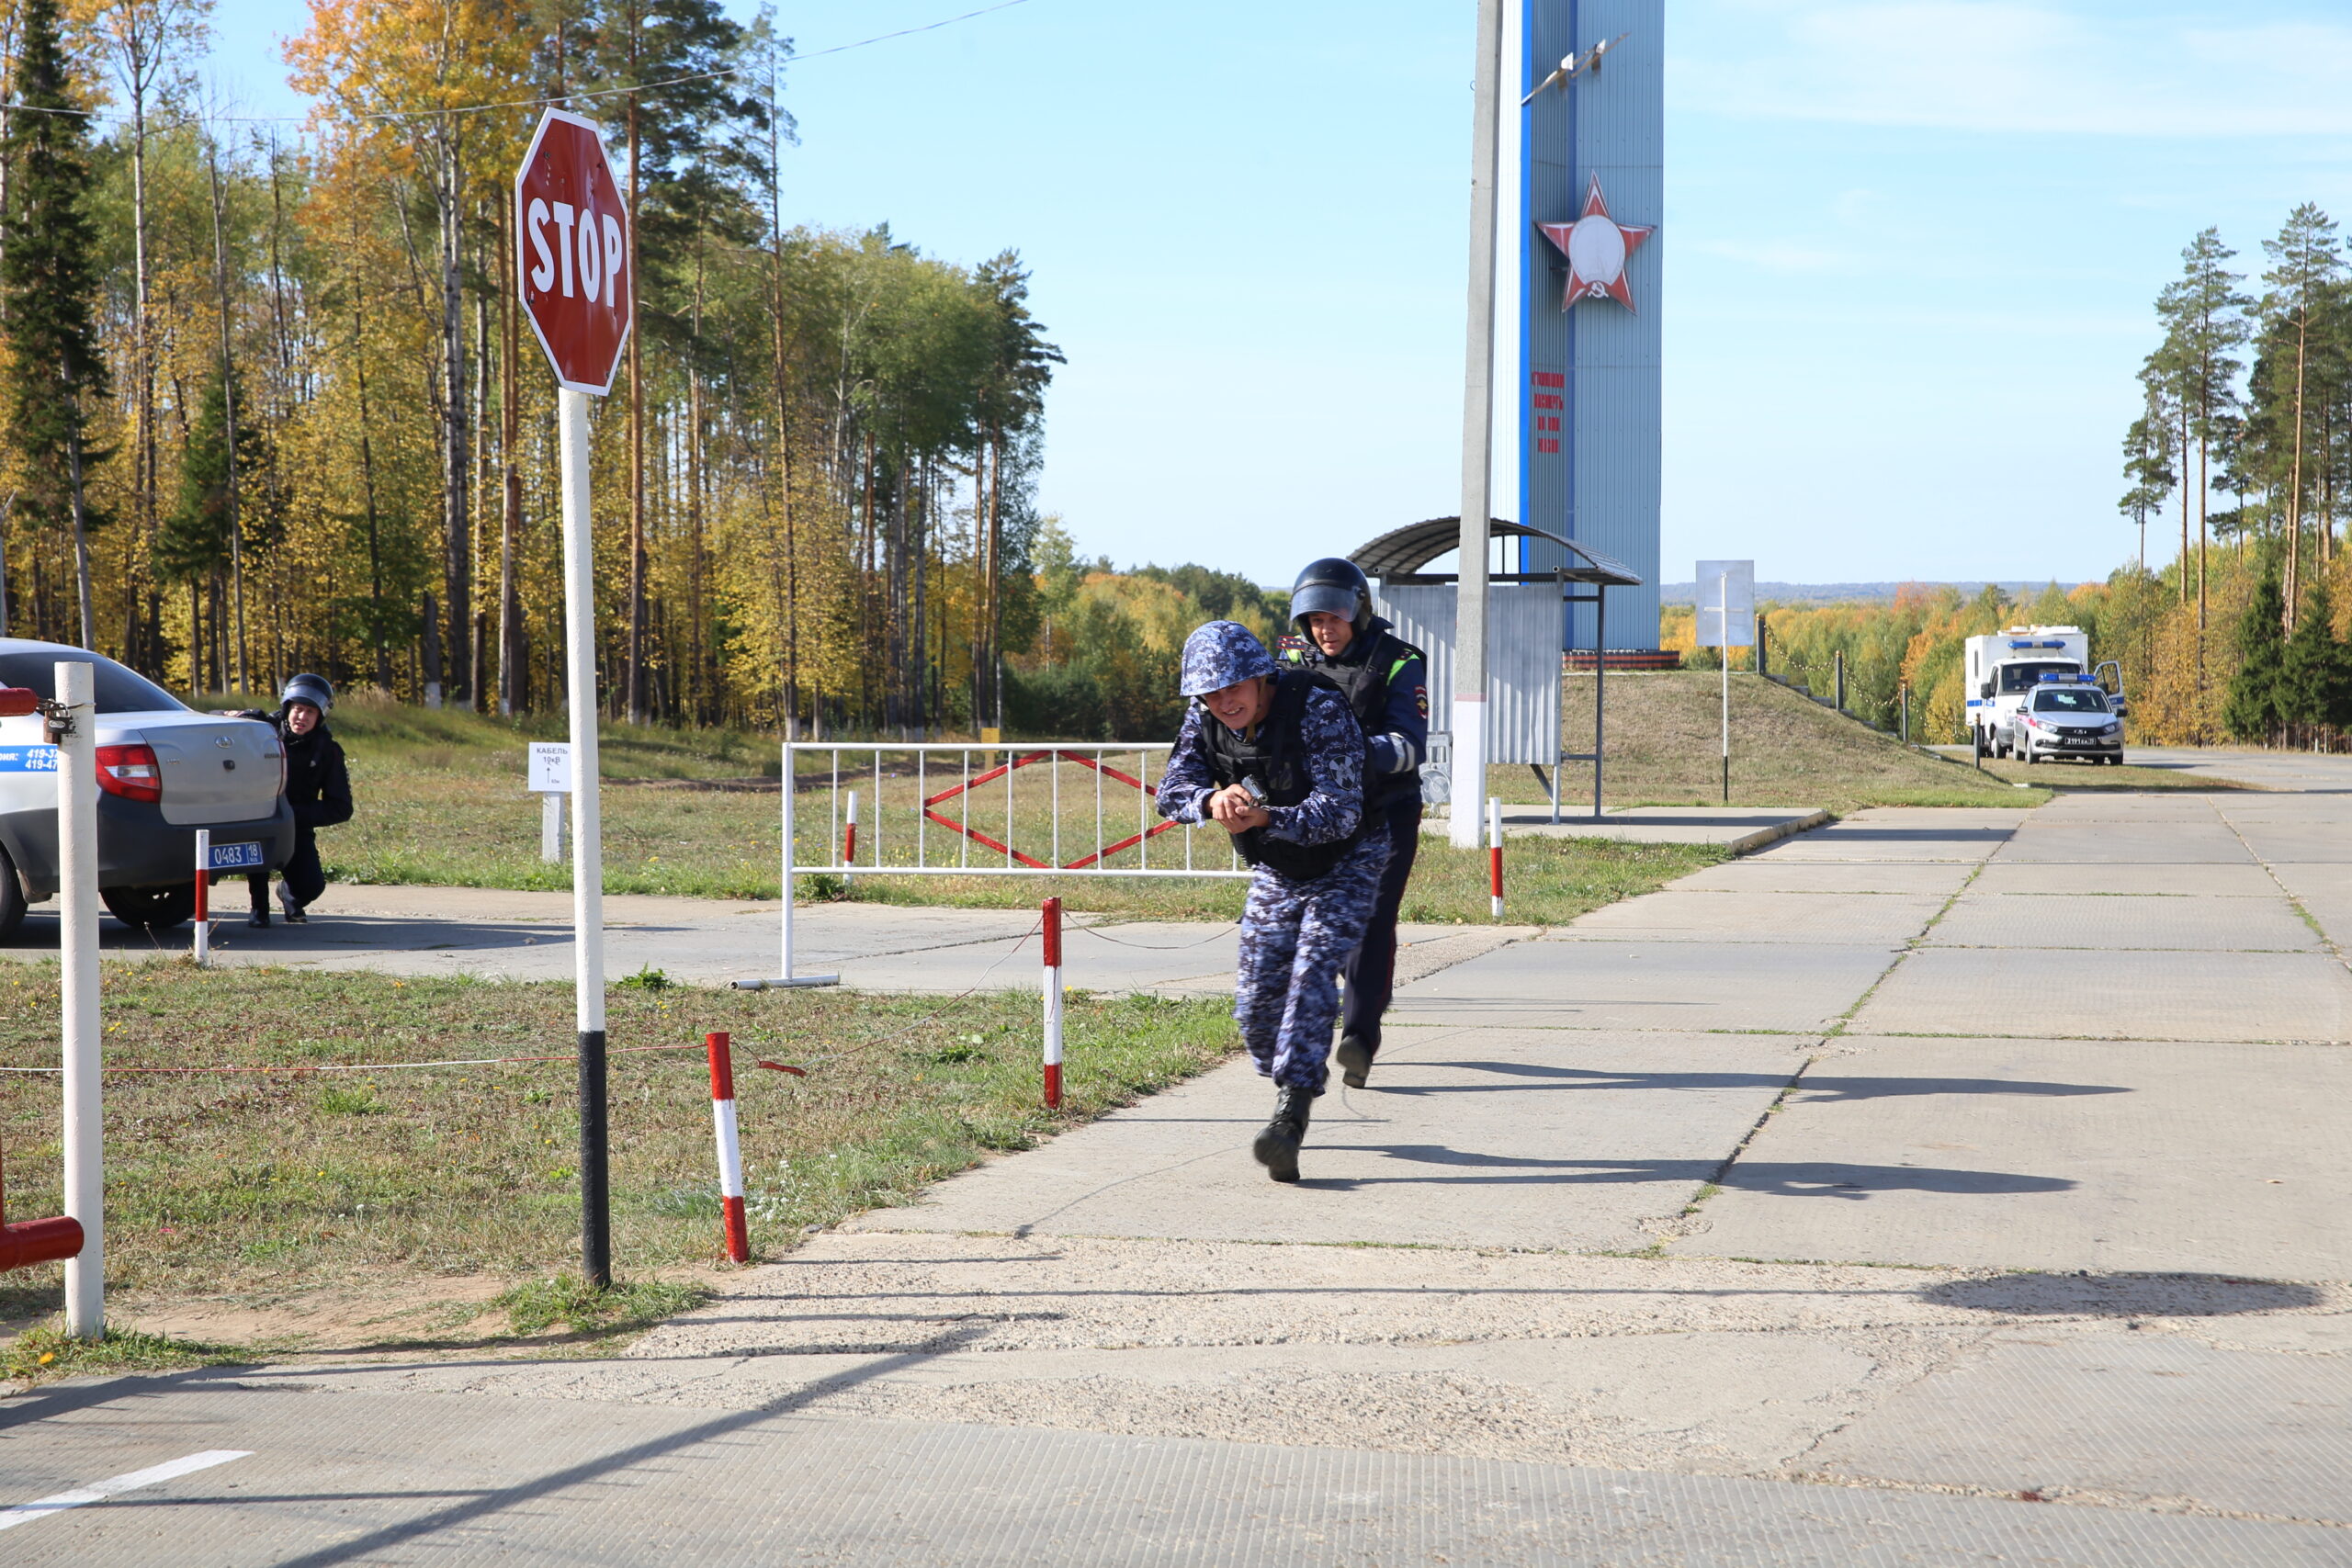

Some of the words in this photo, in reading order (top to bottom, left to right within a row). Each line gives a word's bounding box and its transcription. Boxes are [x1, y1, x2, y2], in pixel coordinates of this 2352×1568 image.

[528, 197, 623, 308] STOP
[214, 846, 243, 864] 0483
[248, 844, 258, 857] 18
